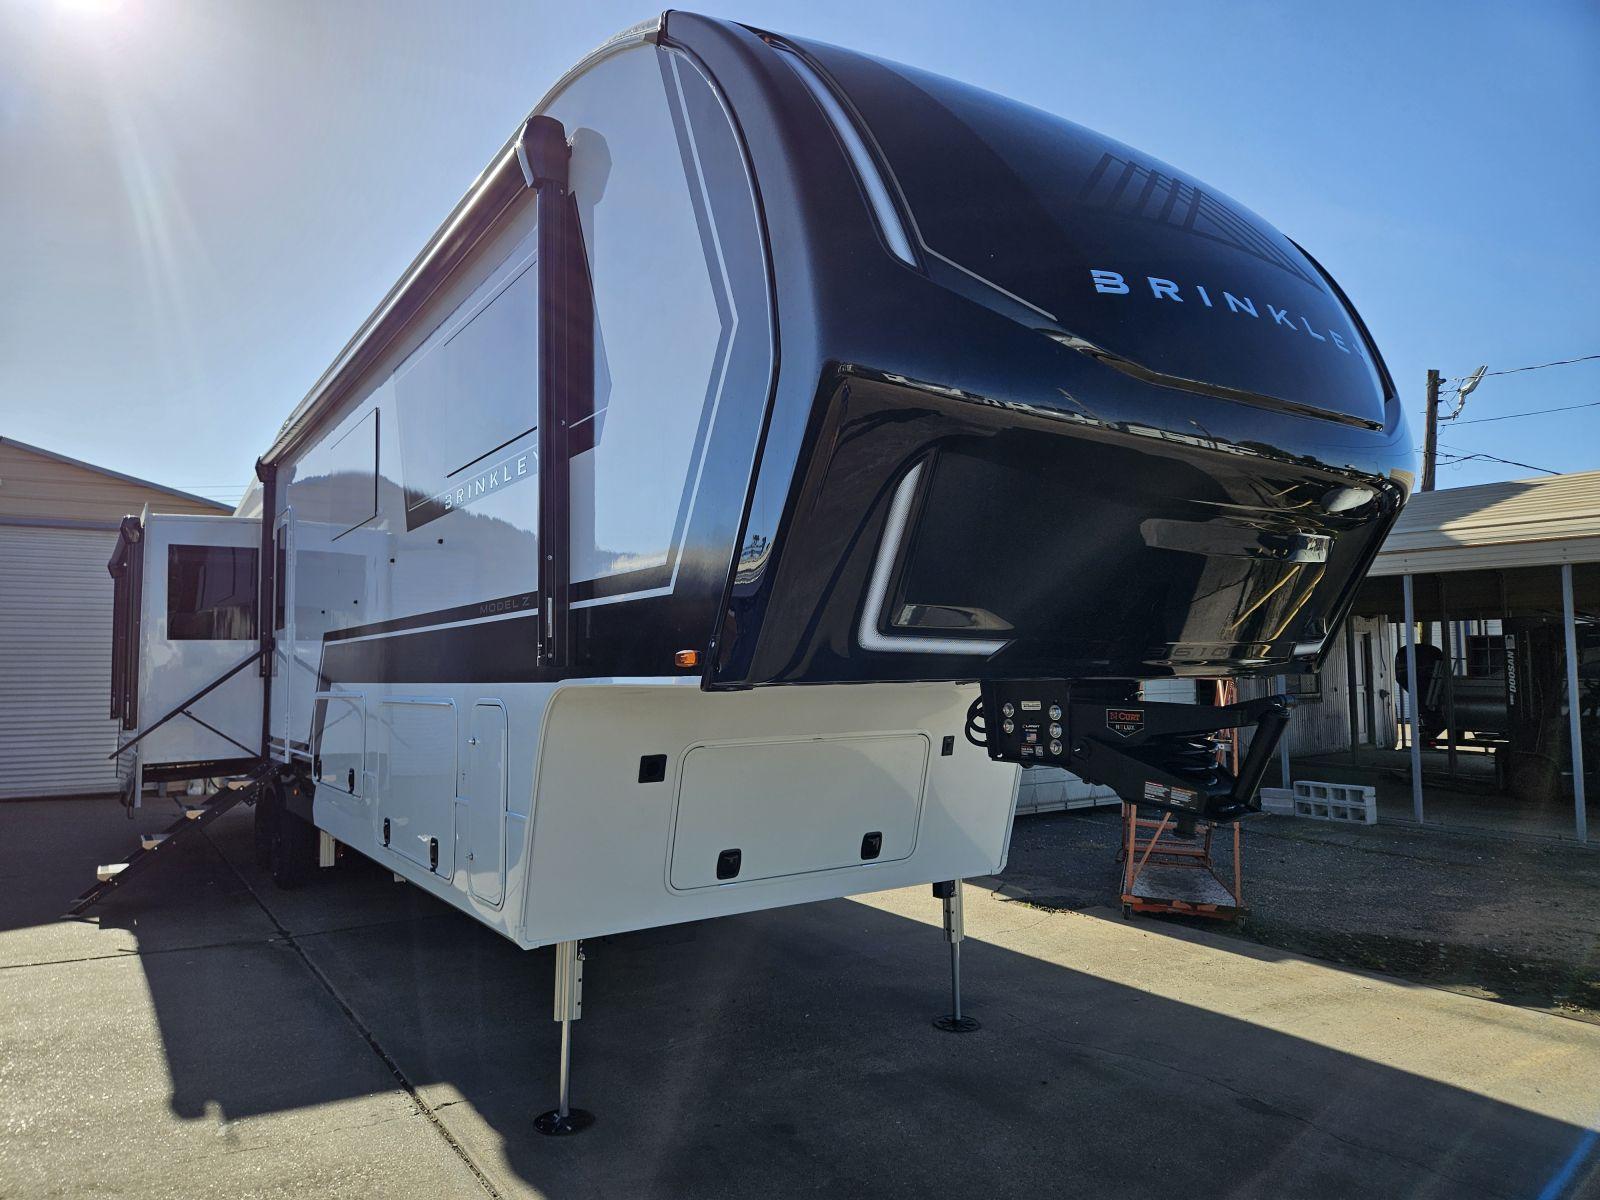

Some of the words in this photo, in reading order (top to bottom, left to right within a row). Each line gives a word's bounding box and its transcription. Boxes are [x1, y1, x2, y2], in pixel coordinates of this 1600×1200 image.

[480, 599, 519, 617] MODEL
[522, 597, 530, 606] Z
[1507, 651, 1516, 693] DOOSAN
